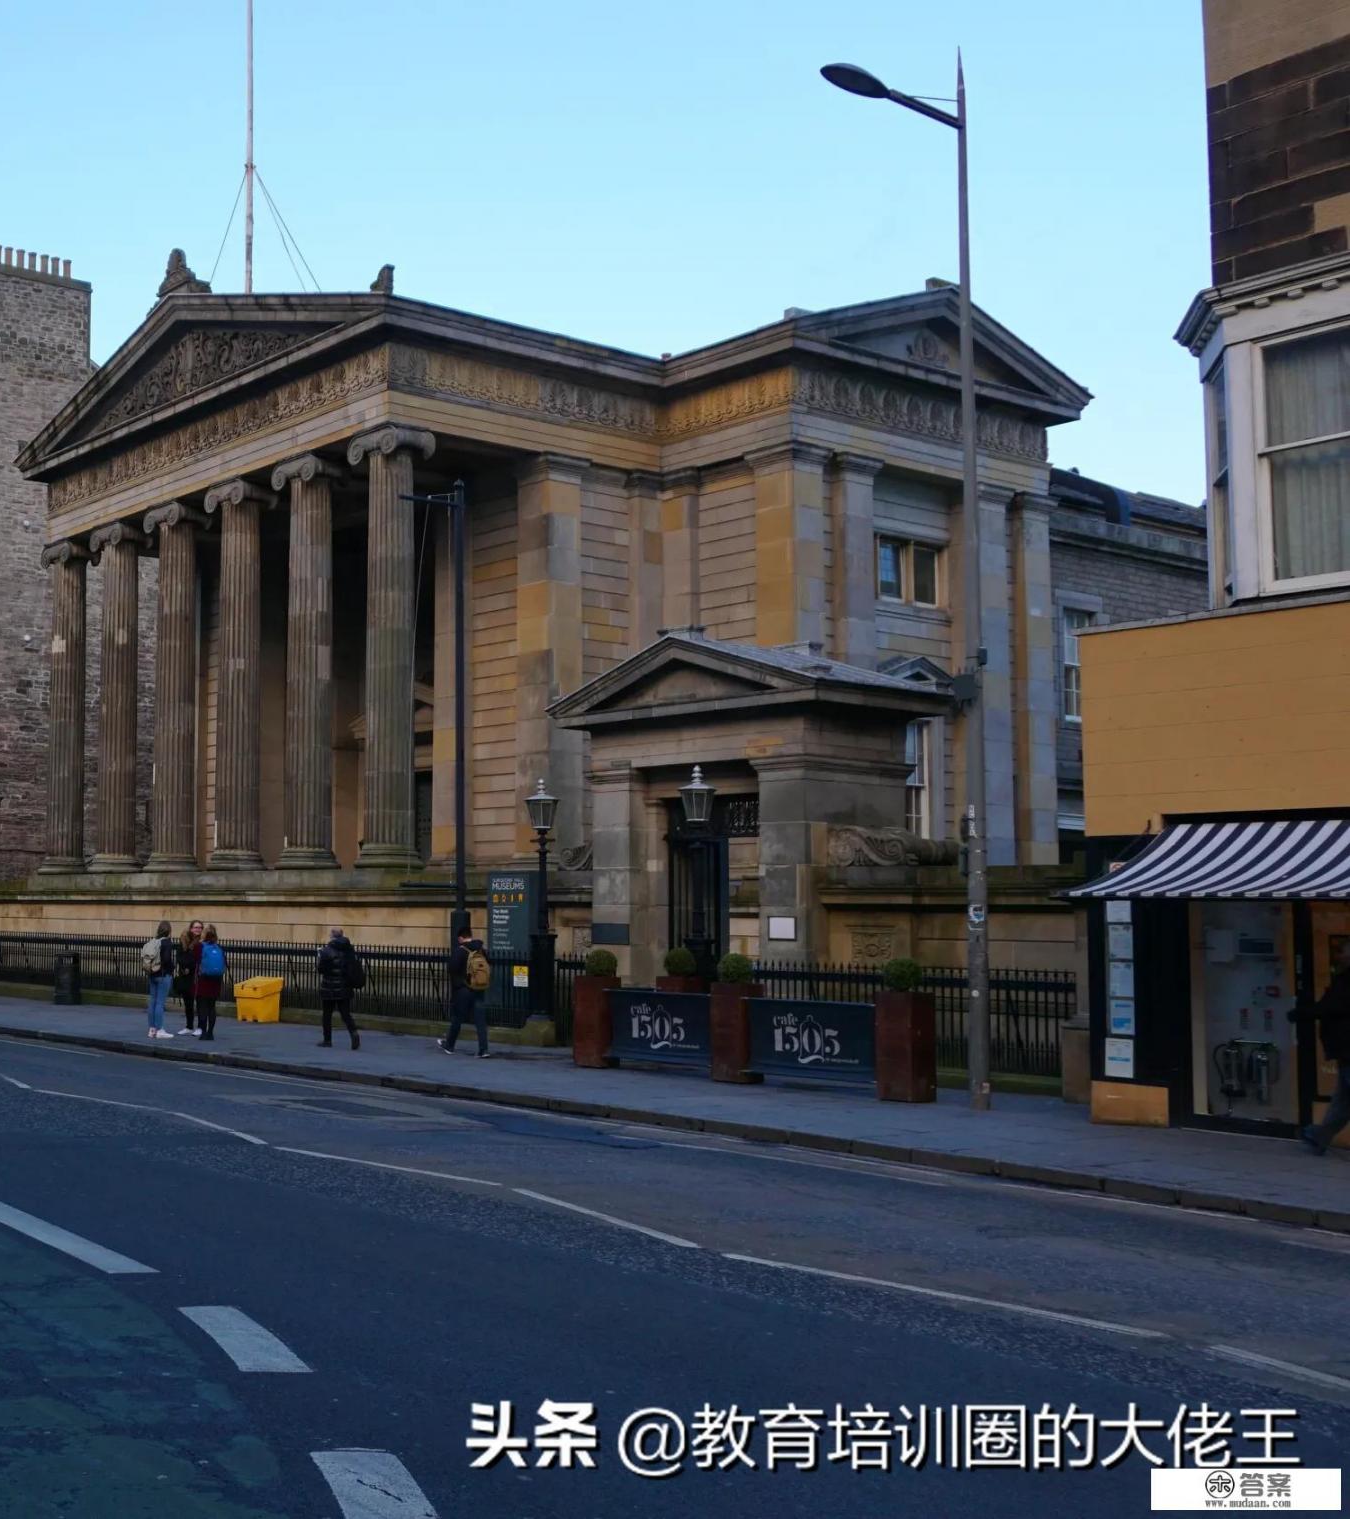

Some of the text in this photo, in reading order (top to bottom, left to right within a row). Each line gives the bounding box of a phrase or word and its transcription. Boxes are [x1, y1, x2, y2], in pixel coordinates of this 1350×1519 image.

[492, 883, 525, 891] MUSEUMS
[631, 1015, 685, 1042] 1505
[773, 1026, 841, 1056] 1505
